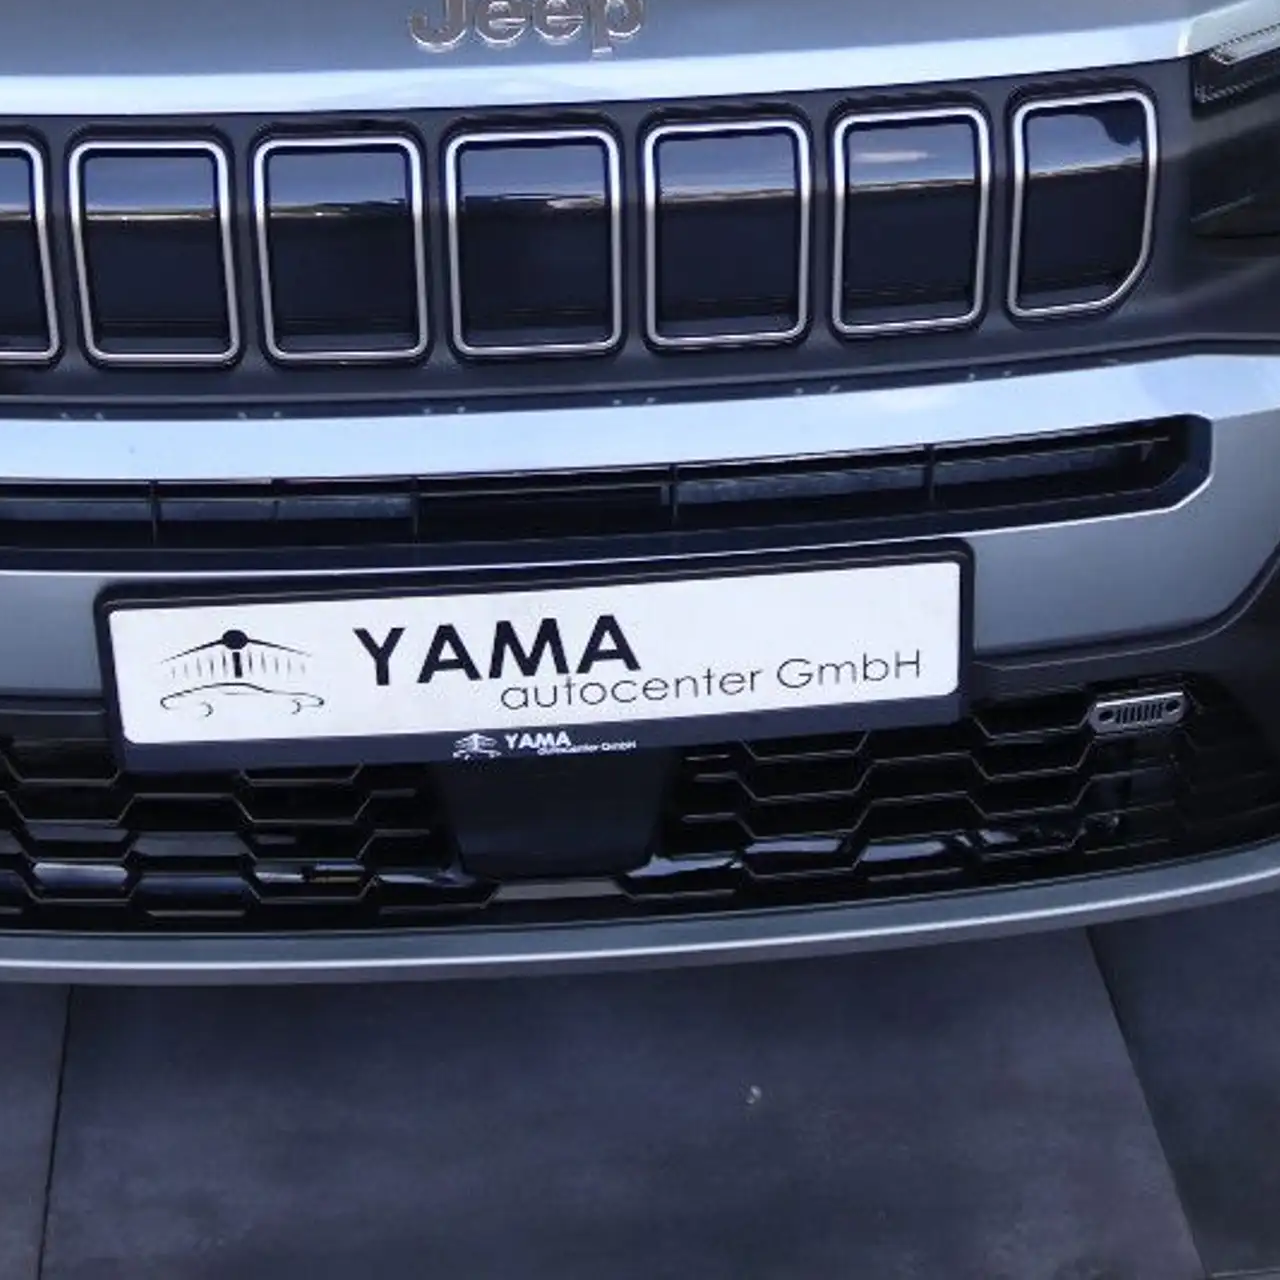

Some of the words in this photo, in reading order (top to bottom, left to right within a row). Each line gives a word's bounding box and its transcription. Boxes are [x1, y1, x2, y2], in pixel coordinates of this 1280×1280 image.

[353, 615, 641, 686] YAMA
[500, 668, 762, 710] autocenter
[777, 649, 921, 689] GmbH
[504, 731, 571, 750] YAMA
